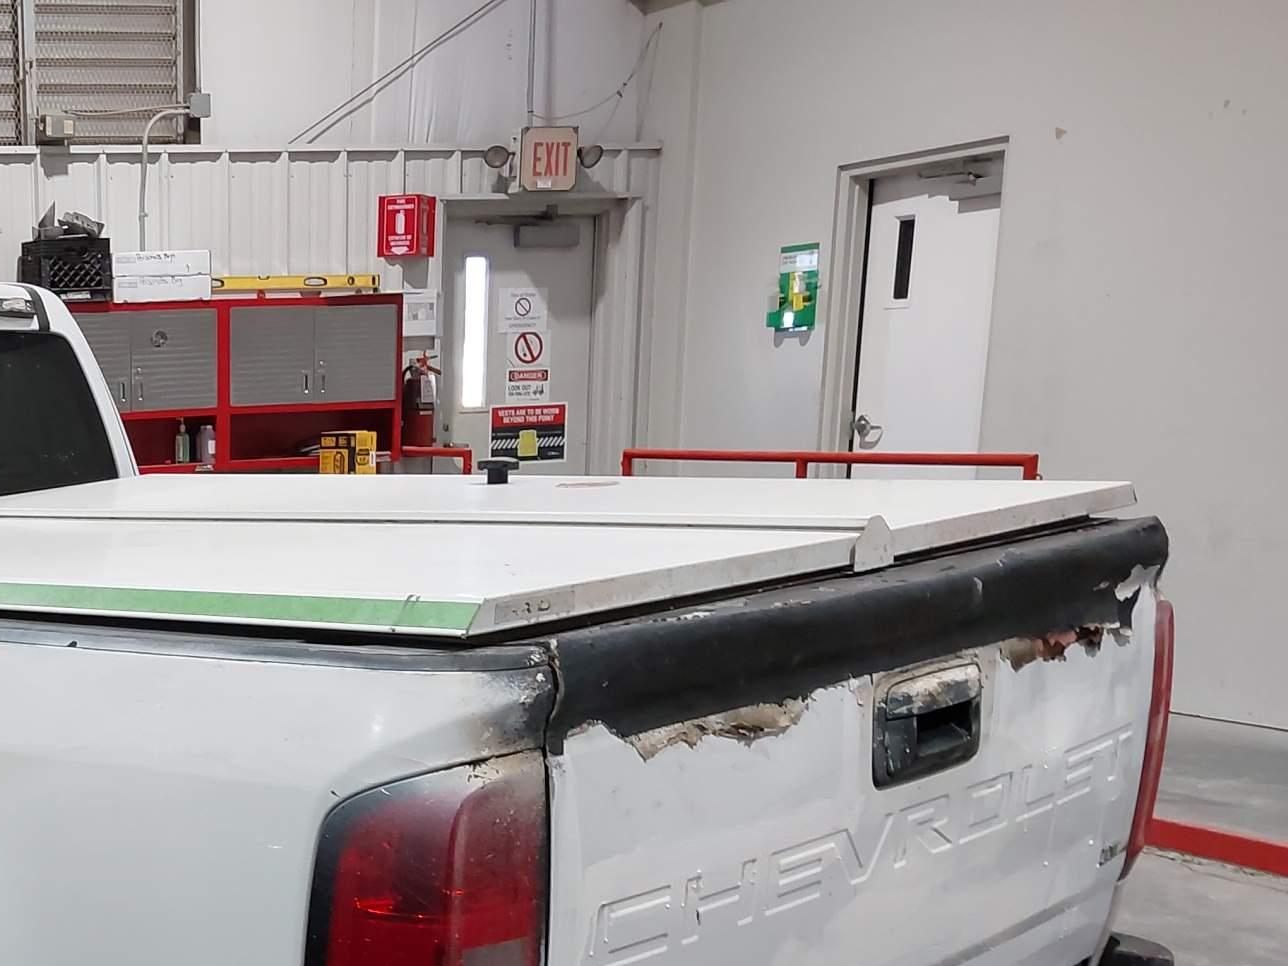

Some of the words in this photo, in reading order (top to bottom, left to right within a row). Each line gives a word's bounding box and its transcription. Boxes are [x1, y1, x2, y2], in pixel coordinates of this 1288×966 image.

[532, 142, 572, 177] EXIT
[514, 372, 543, 380] DANGER
[498, 409, 515, 417] VESTS
[503, 416, 525, 424] BEYOND
[526, 415, 537, 423] THIS
